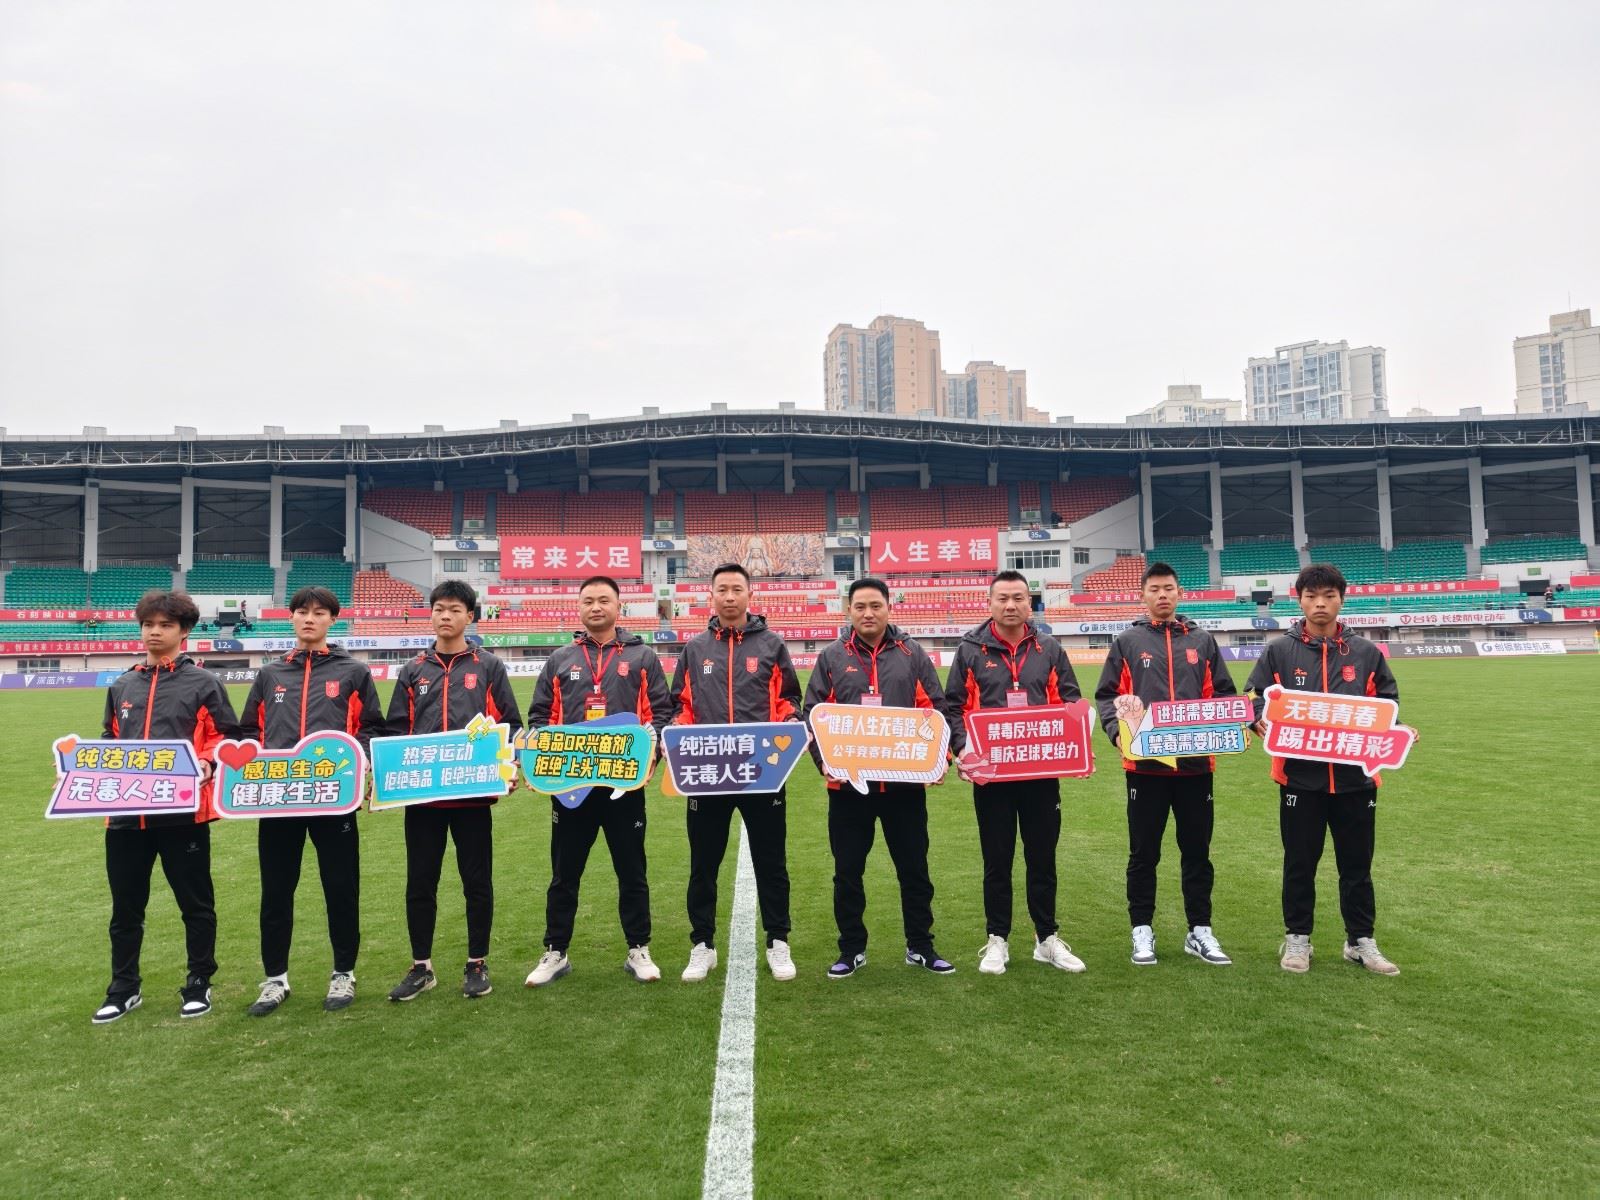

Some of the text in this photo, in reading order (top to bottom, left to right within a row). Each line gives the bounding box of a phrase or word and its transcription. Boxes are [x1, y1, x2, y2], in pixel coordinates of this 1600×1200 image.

[511, 546, 631, 569] 常来大足
[877, 538, 992, 564] 人生幸福
[1415, 645, 1464, 656] 卡尔美体育
[275, 692, 285, 703] 32
[1157, 700, 1247, 724] 进球需要配合
[1284, 699, 1379, 728] 无毒青春
[829, 714, 917, 738] 健康人生无毒路
[987, 719, 1064, 741] 禁毒反兴奋剂
[401, 741, 474, 766] 热爱运动
[679, 734, 756, 756] 纯洁体育
[990, 742, 1079, 764] 重庆足球更给力
[1148, 730, 1240, 754] 禁毒需要你我
[1276, 727, 1395, 759] 踢出精彩
[74, 746, 177, 771] 纯洁体育
[242, 758, 337, 781] 感恩生命
[384, 763, 500, 792] 拒绝毒品 拒绝兴奋剂
[679, 763, 757, 786] 无毒人生
[67, 776, 177, 803] 无毒人生
[231, 780, 341, 807] 健康生活
[1286, 794, 1298, 807] 37
